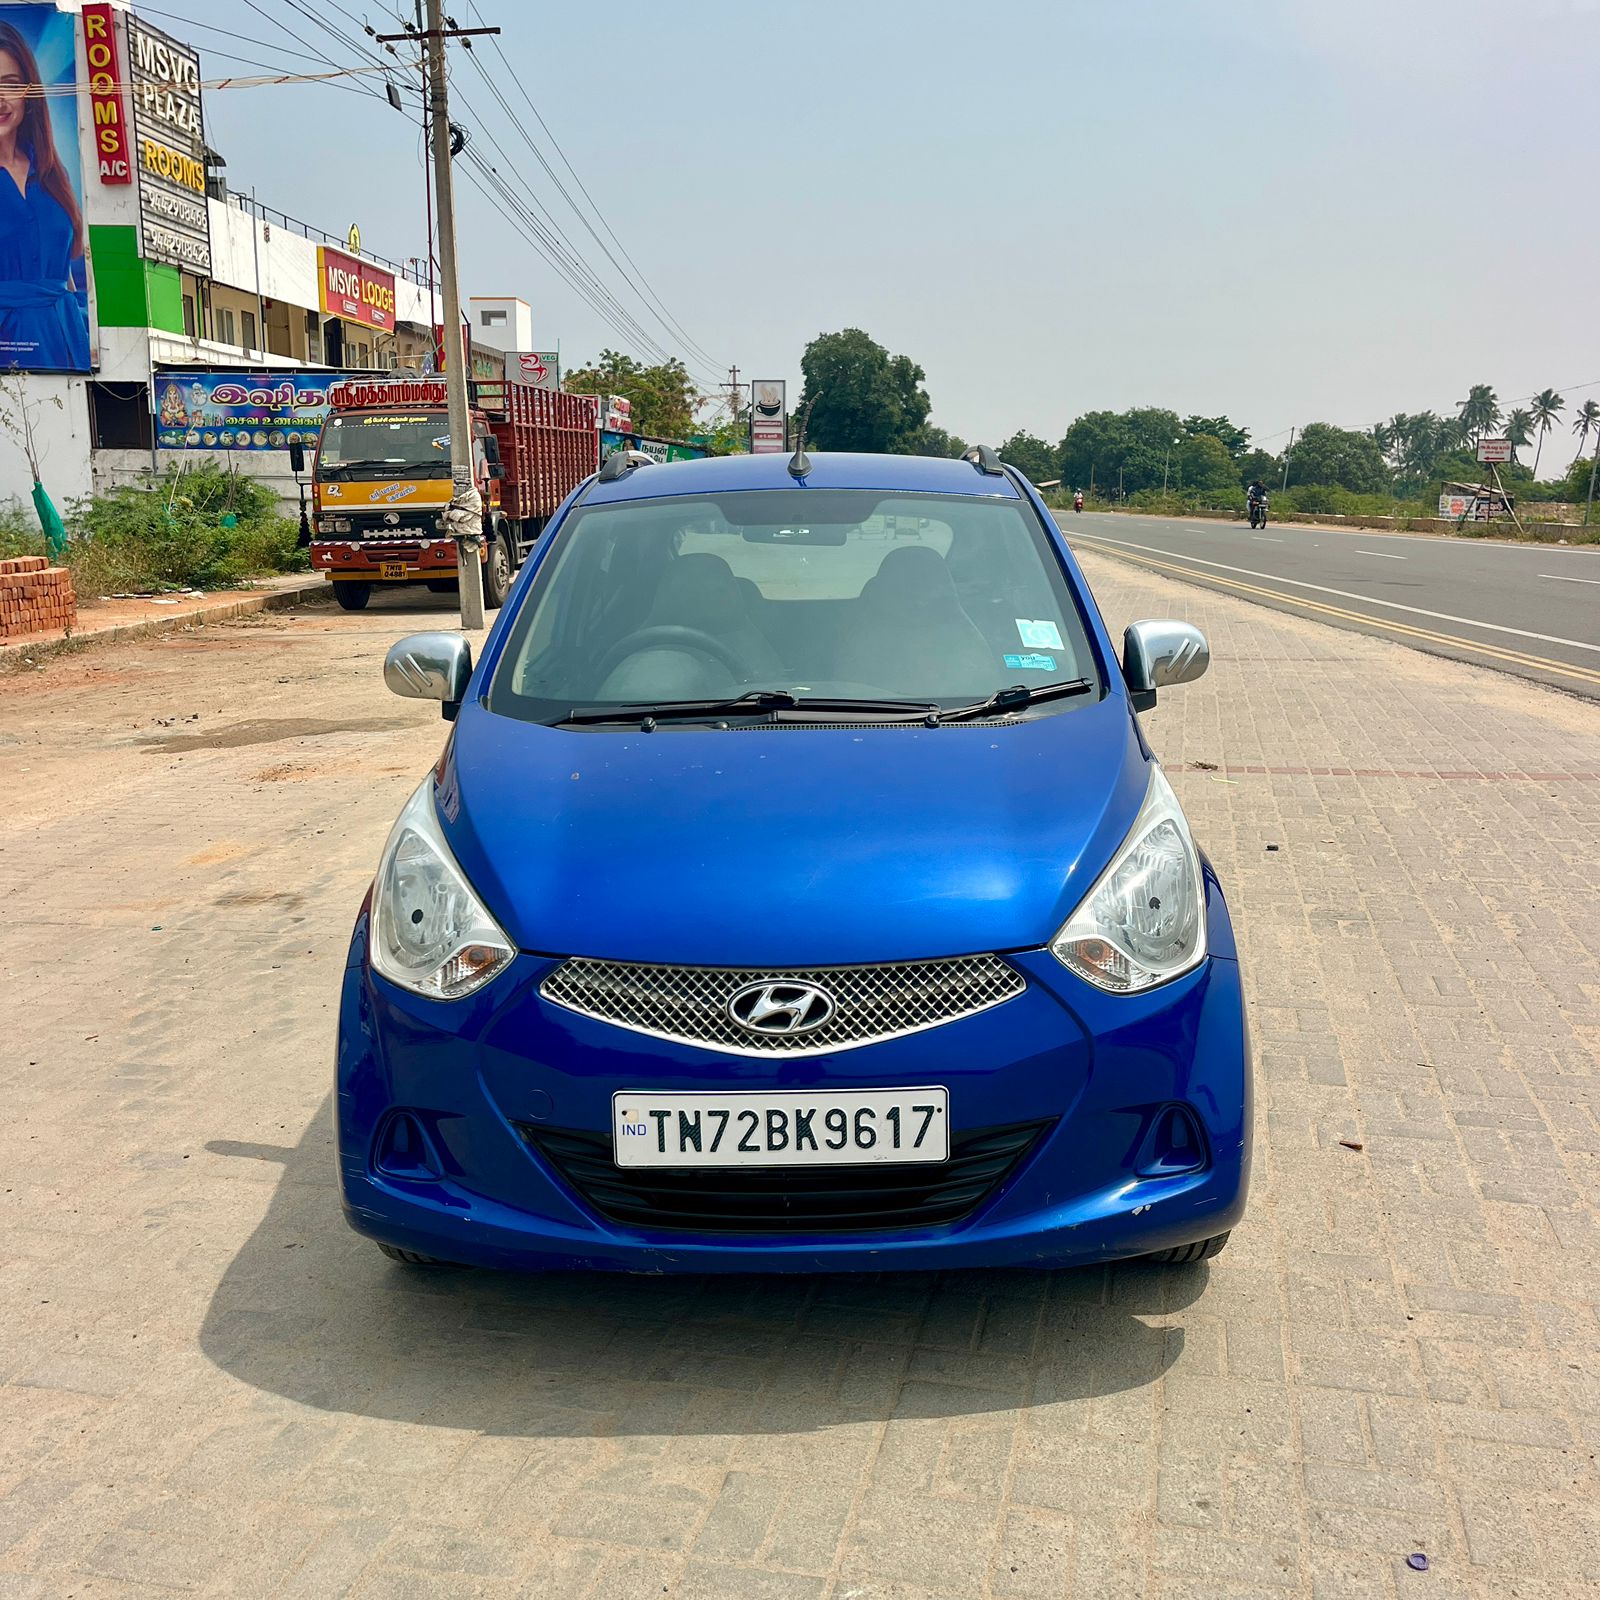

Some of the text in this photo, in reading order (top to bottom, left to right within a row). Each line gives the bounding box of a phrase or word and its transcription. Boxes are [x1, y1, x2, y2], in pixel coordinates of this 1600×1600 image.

[86, 15, 119, 153] ROOMS
[137, 32, 199, 97] MSVG
[143, 80, 200, 135] PLAZA
[100, 160, 127, 176] A/C
[144, 140, 205, 193] ROOMS
[328, 265, 394, 313] MSVG LODGE
[225, 416, 259, 426] சைவ
[363, 528, 424, 538] EICHER
[621, 1105, 935, 1152] IND TN72BK9617
